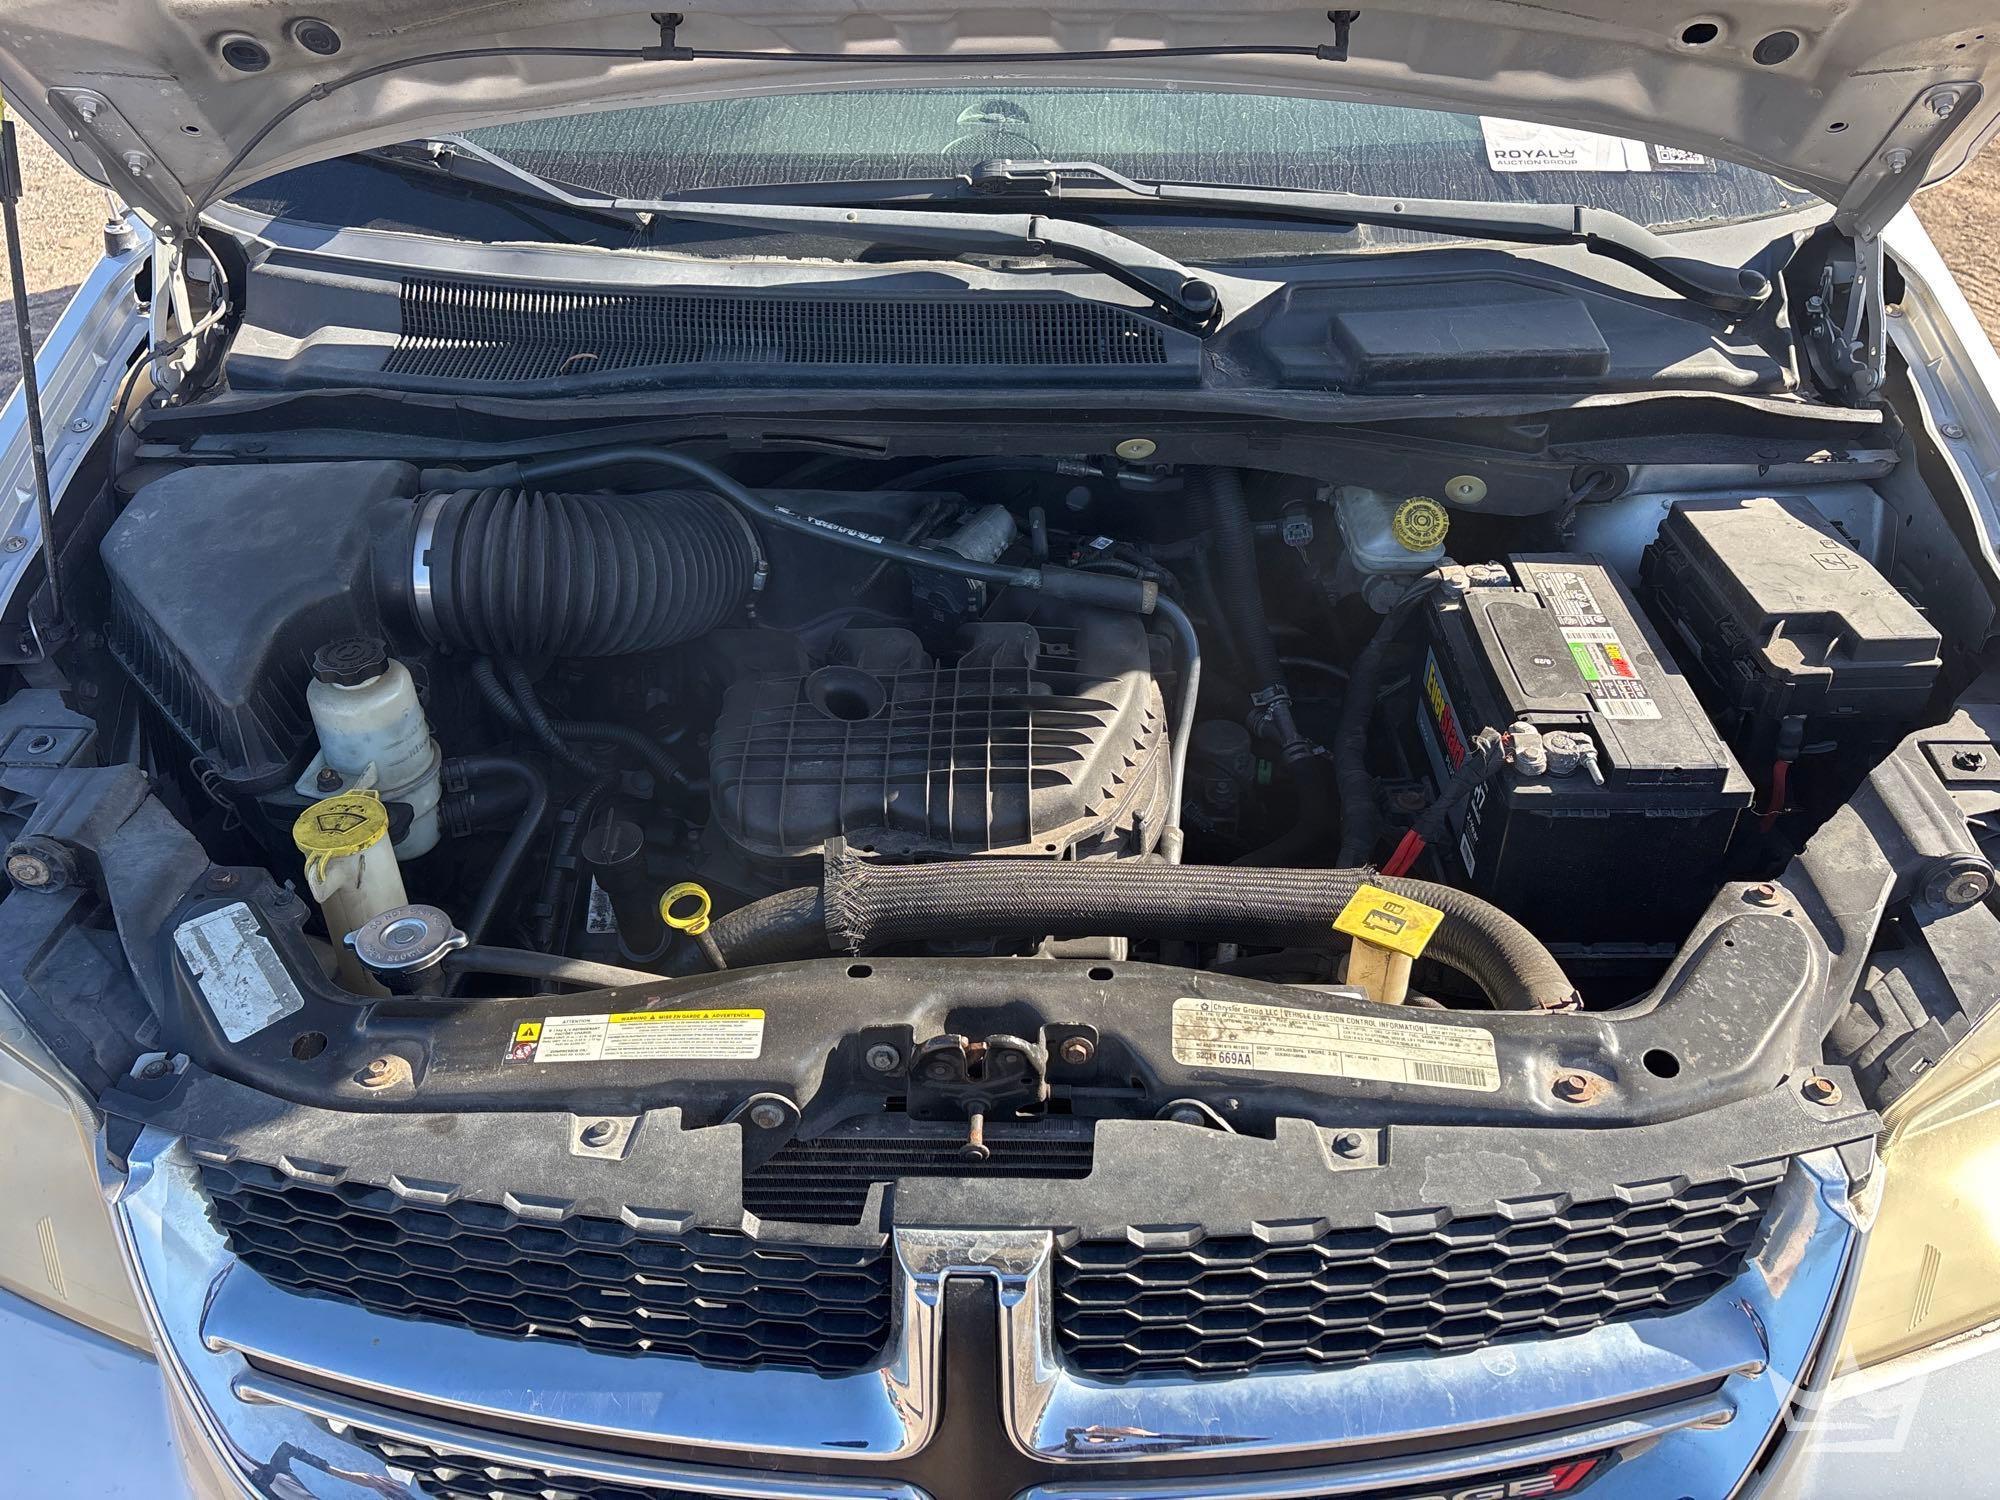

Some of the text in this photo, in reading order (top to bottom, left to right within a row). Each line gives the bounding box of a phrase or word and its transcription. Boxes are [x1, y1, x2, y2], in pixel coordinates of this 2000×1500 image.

[1494, 149, 1559, 159] ROYAL
[384, 909, 402, 921] NOT
[1213, 1003, 1241, 1014] Chrysler
[1243, 1006, 1264, 1016] Group
[1284, 1010, 1311, 1020] VEHICLE
[1313, 1013, 1345, 1024] EMISSION
[1346, 1018, 1377, 1028] CONTROL
[1378, 1021, 1424, 1032] INFORMATION
[1218, 1051, 1252, 1065] 669AA
